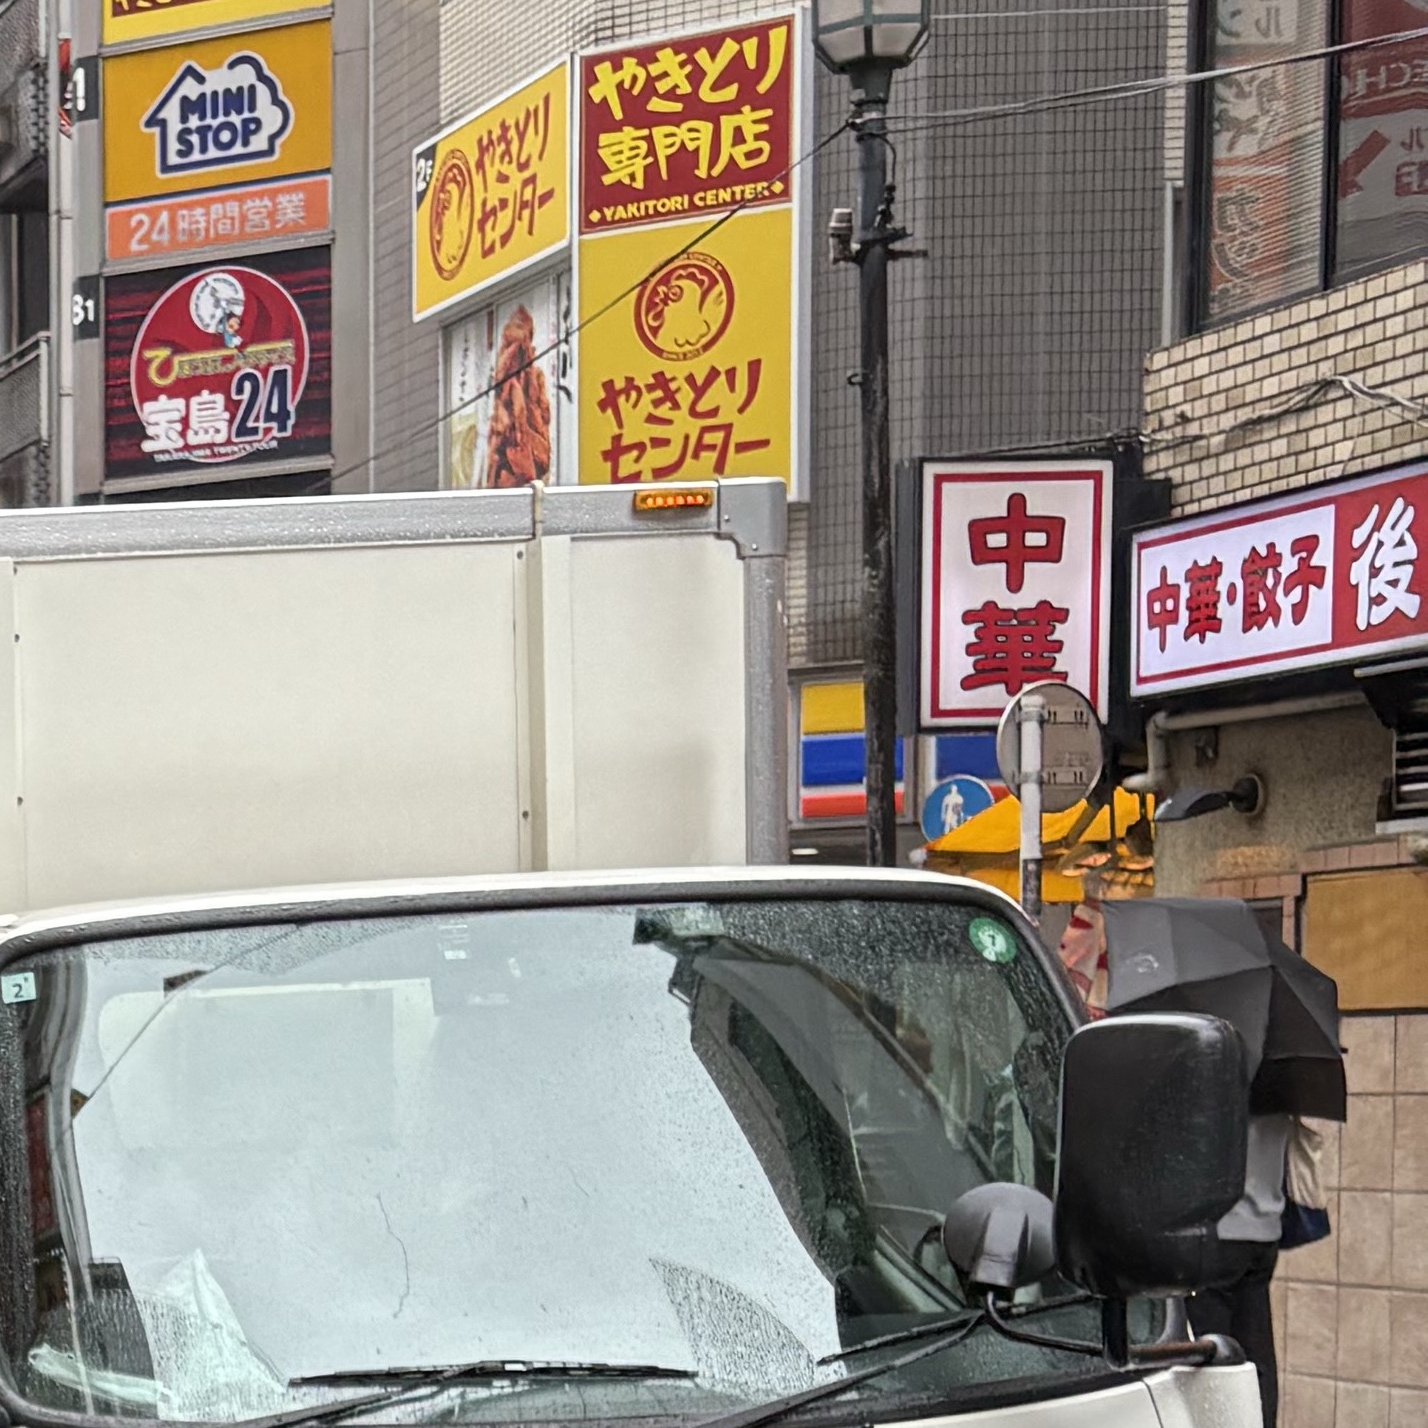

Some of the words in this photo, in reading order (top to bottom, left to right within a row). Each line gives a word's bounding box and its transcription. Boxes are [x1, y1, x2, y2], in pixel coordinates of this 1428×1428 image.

[180, 84, 257, 125] MINI
[588, 25, 787, 121] やきとり
[176, 117, 262, 159] STOP
[476, 91, 551, 194] やきとり
[598, 105, 774, 190] 専門店
[128, 191, 307, 252] 24時間営業
[478, 172, 556, 260] センター
[603, 193, 689, 222] YAKITORI
[693, 181, 770, 207] CENTER
[141, 364, 296, 453] 宝島24
[597, 357, 763, 430] やきとり
[600, 422, 771, 484] センター
[961, 493, 1070, 697] 中華
[1147, 534, 1327, 654] 中華・餃子
[1350, 496, 1421, 631] 後
